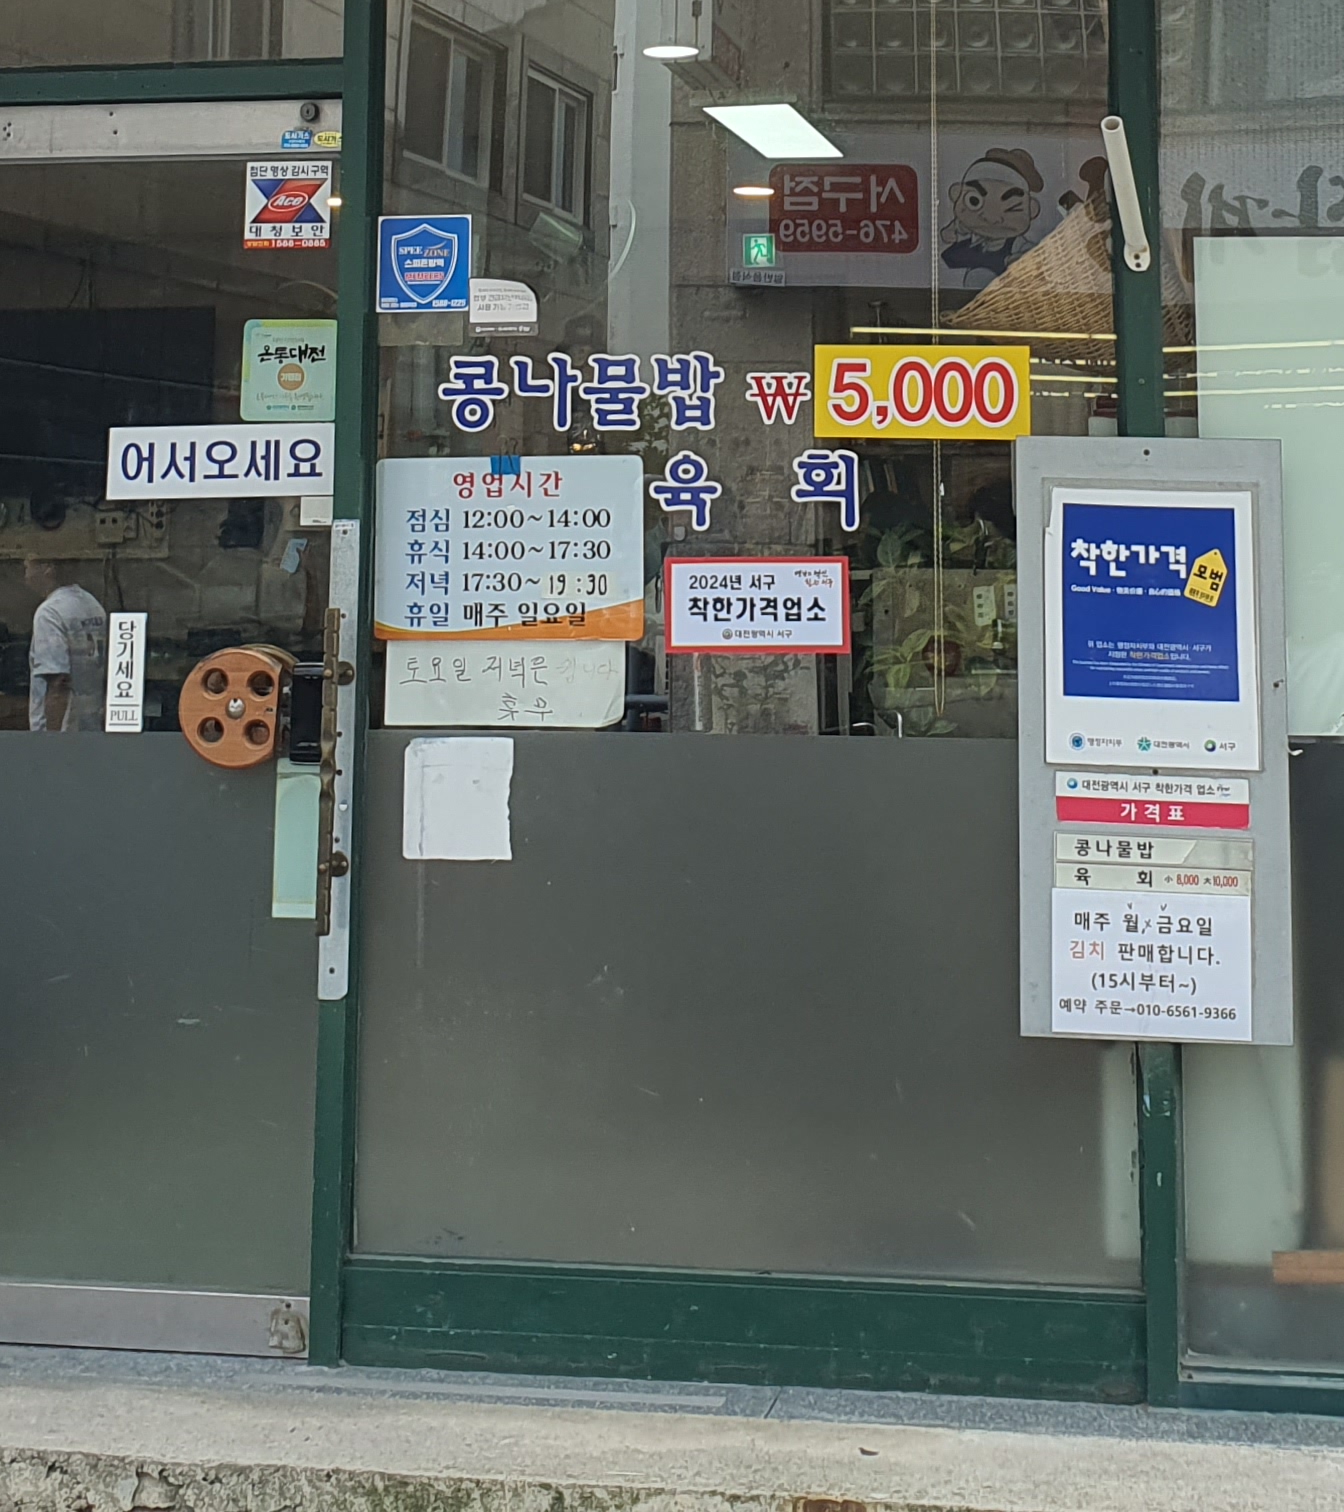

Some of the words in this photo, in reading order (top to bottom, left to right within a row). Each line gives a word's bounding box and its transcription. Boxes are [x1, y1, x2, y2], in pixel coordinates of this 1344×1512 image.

[438, 351, 725, 432] 콩나물밥
[828, 356, 1018, 430] 5,000
[121, 438, 323, 484] 어서오세요
[453, 470, 563, 499] 영업시간
[406, 508, 451, 533] 점심
[462, 508, 611, 529] 12:00~14:00
[405, 539, 451, 564] 휴식
[462, 540, 611, 560] 14:00~17:30
[1070, 538, 1187, 579] 착한가격
[405, 570, 451, 596] 저녁
[688, 574, 742, 591] 2024년
[749, 574, 775, 590] 서구
[1193, 564, 1224, 592] 모범
[404, 602, 450, 627] 휴일
[463, 602, 508, 627] 매주
[518, 601, 586, 627] 일요일
[688, 596, 827, 622] 착한가격업소
[777, 629, 793, 639] 서구
[113, 620, 137, 699] 당기세요
[399, 657, 471, 685] 토요일
[110, 709, 138, 722] PULL
[1219, 742, 1237, 751] 서구
[1081, 781, 1128, 793] 대전광역시
[1132, 782, 1151, 793] 서구
[1155, 783, 1193, 795] 착한가격
[1197, 784, 1216, 796] 업소
[1120, 803, 1185, 823] 가격표
[1074, 839, 1154, 859] 콩나물밥
[1176, 874, 1199, 887] 8,000
[1213, 875, 1238, 888] 10,000
[1074, 911, 1111, 931] 매주
[1156, 915, 1213, 936] 금요일
[1070, 940, 1105, 961] 김치
[1117, 942, 1221, 966] 판매합니다.
[1091, 972, 1197, 996] (15시부터~)
[1059, 998, 1087, 1013] 예약
